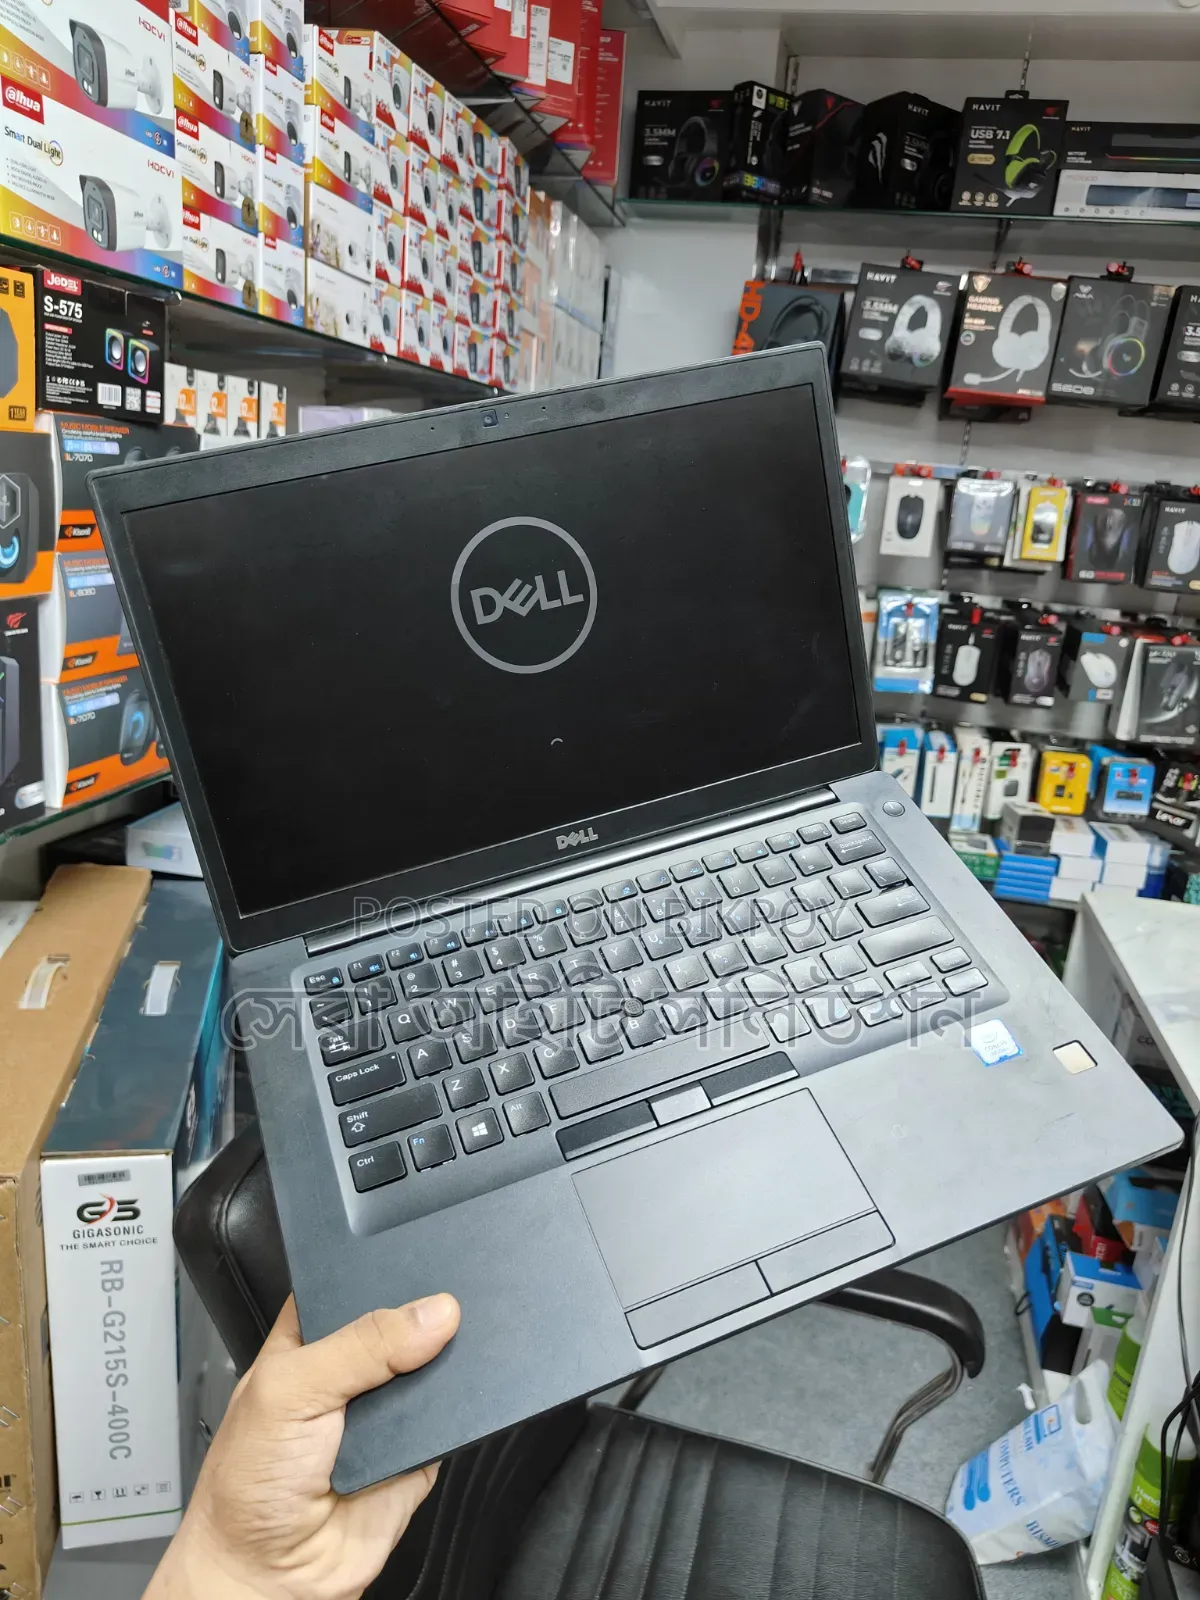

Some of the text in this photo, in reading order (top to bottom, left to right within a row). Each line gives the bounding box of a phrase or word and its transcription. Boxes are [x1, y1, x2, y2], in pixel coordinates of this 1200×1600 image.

[138, 16, 166, 42] HDCVI
[644, 100, 671, 108] HAVIT
[972, 103, 1001, 112] HAVIT
[907, 103, 929, 117] HAVIT
[970, 129, 1011, 140] USB 7.1
[4, 126, 62, 159] Smart Dual Light
[147, 160, 175, 178] HDCVI
[866, 271, 897, 284] HAVIT
[968, 294, 1000, 305] GAMING
[44, 295, 83, 319] S-575
[470, 569, 584, 625] DELL
[556, 827, 599, 850] DELL
[648, 934, 659, 943] U
[391, 949, 400, 958] F2
[491, 947, 499, 956] $
[610, 946, 619, 956] Y
[712, 951, 721, 960] K
[353, 963, 364, 971] F1
[451, 959, 459, 968] #
[569, 959, 580, 968] T
[309, 974, 327, 984] Esc
[407, 973, 416, 981] @
[528, 973, 539, 982] R
[632, 977, 643, 986] H
[411, 985, 419, 993] 2
[486, 986, 496, 995] E
[398, 1013, 411, 1025] Q
[506, 1019, 517, 1030] D
[629, 1019, 640, 1030] B
[328, 1034, 345, 1043] Tab
[417, 1048, 429, 1060] A
[543, 1048, 555, 1059] C
[335, 1063, 380, 1083] Caps Lock
[498, 1063, 510, 1074] X
[451, 1080, 461, 1092] Z
[510, 1103, 522, 1113] Alt
[346, 1110, 369, 1124] Shift
[412, 1137, 425, 1146] Fn
[356, 1156, 375, 1168] Ctrl
[72, 1225, 145, 1240] GIGASONIC
[60, 1237, 159, 1252] THE SMART CHOICE
[100, 1260, 133, 1461] RB-G215S-400C
